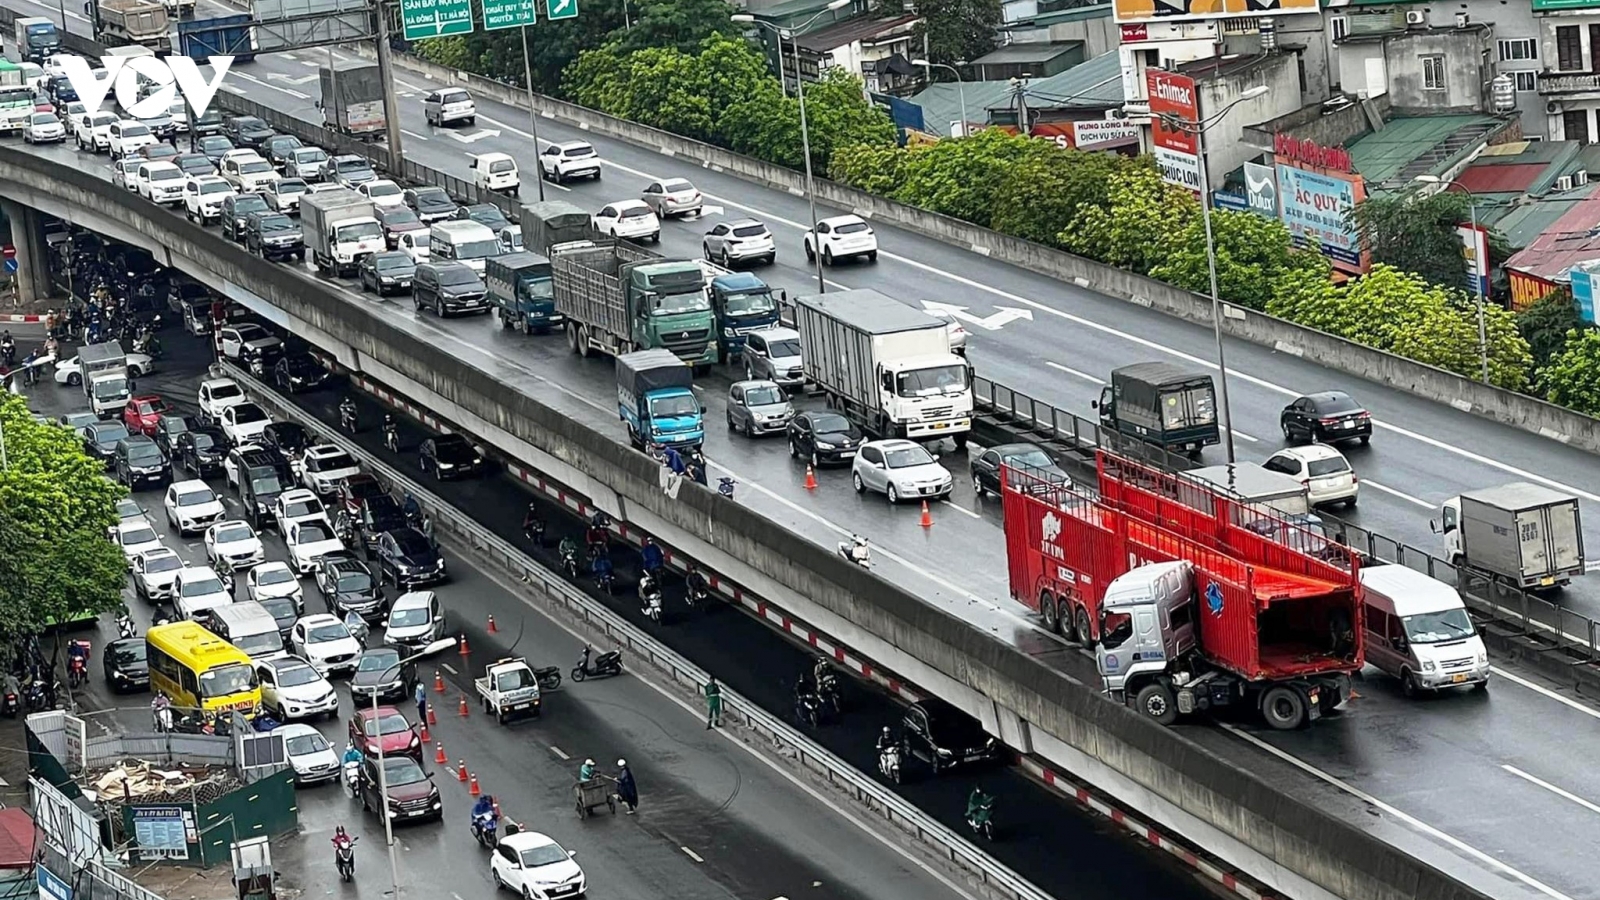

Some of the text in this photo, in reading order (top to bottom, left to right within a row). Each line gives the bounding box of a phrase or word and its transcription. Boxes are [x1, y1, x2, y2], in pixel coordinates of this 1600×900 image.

[1156, 77, 1192, 105] Enimac
[1248, 189, 1273, 211] Dulux
[1314, 193, 1338, 213] QUY
